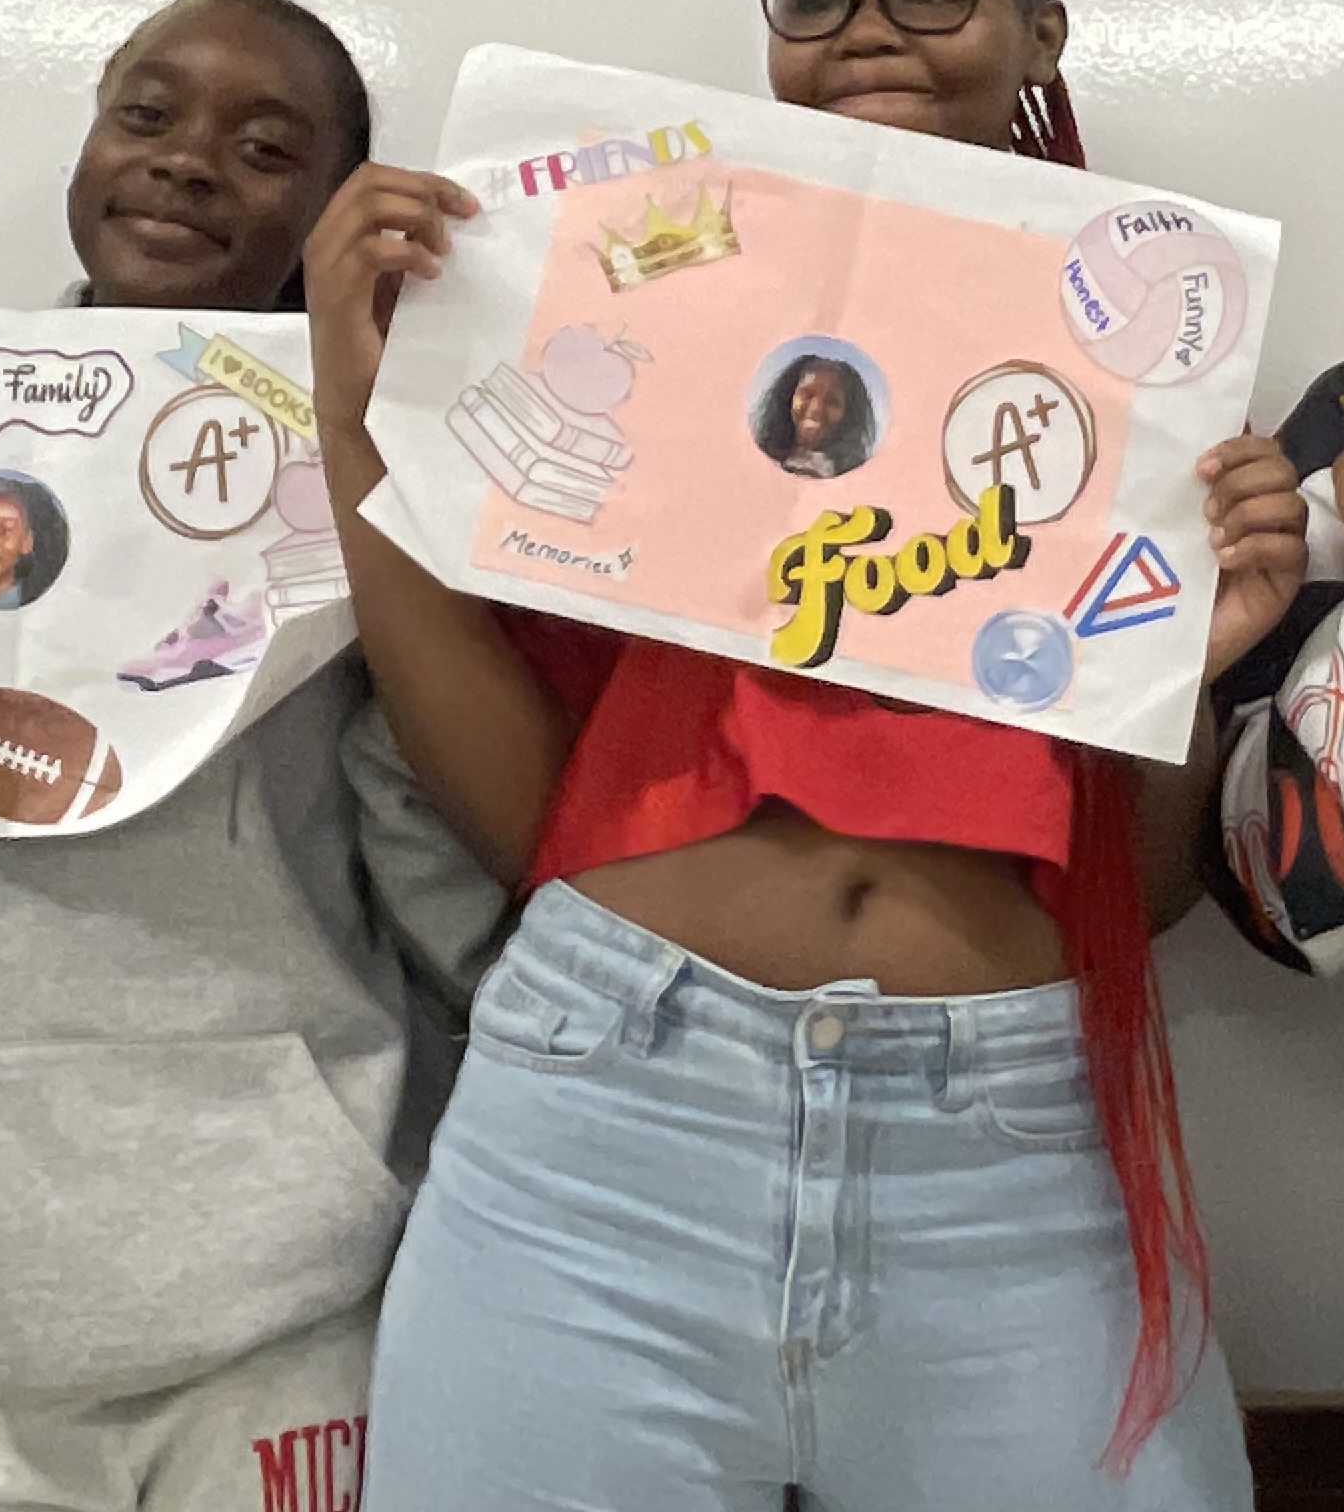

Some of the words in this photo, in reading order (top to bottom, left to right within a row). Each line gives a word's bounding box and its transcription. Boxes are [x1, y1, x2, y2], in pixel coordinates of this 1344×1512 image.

[1116, 209, 1194, 242] Faith
[1178, 271, 1210, 352] Funny
[2, 363, 112, 423] Family
[238, 368, 314, 427] BOOKS
[168, 414, 260, 503] A+
[973, 391, 1059, 492] A+
[498, 529, 613, 574] Memories
[768, 483, 1032, 669] Food
